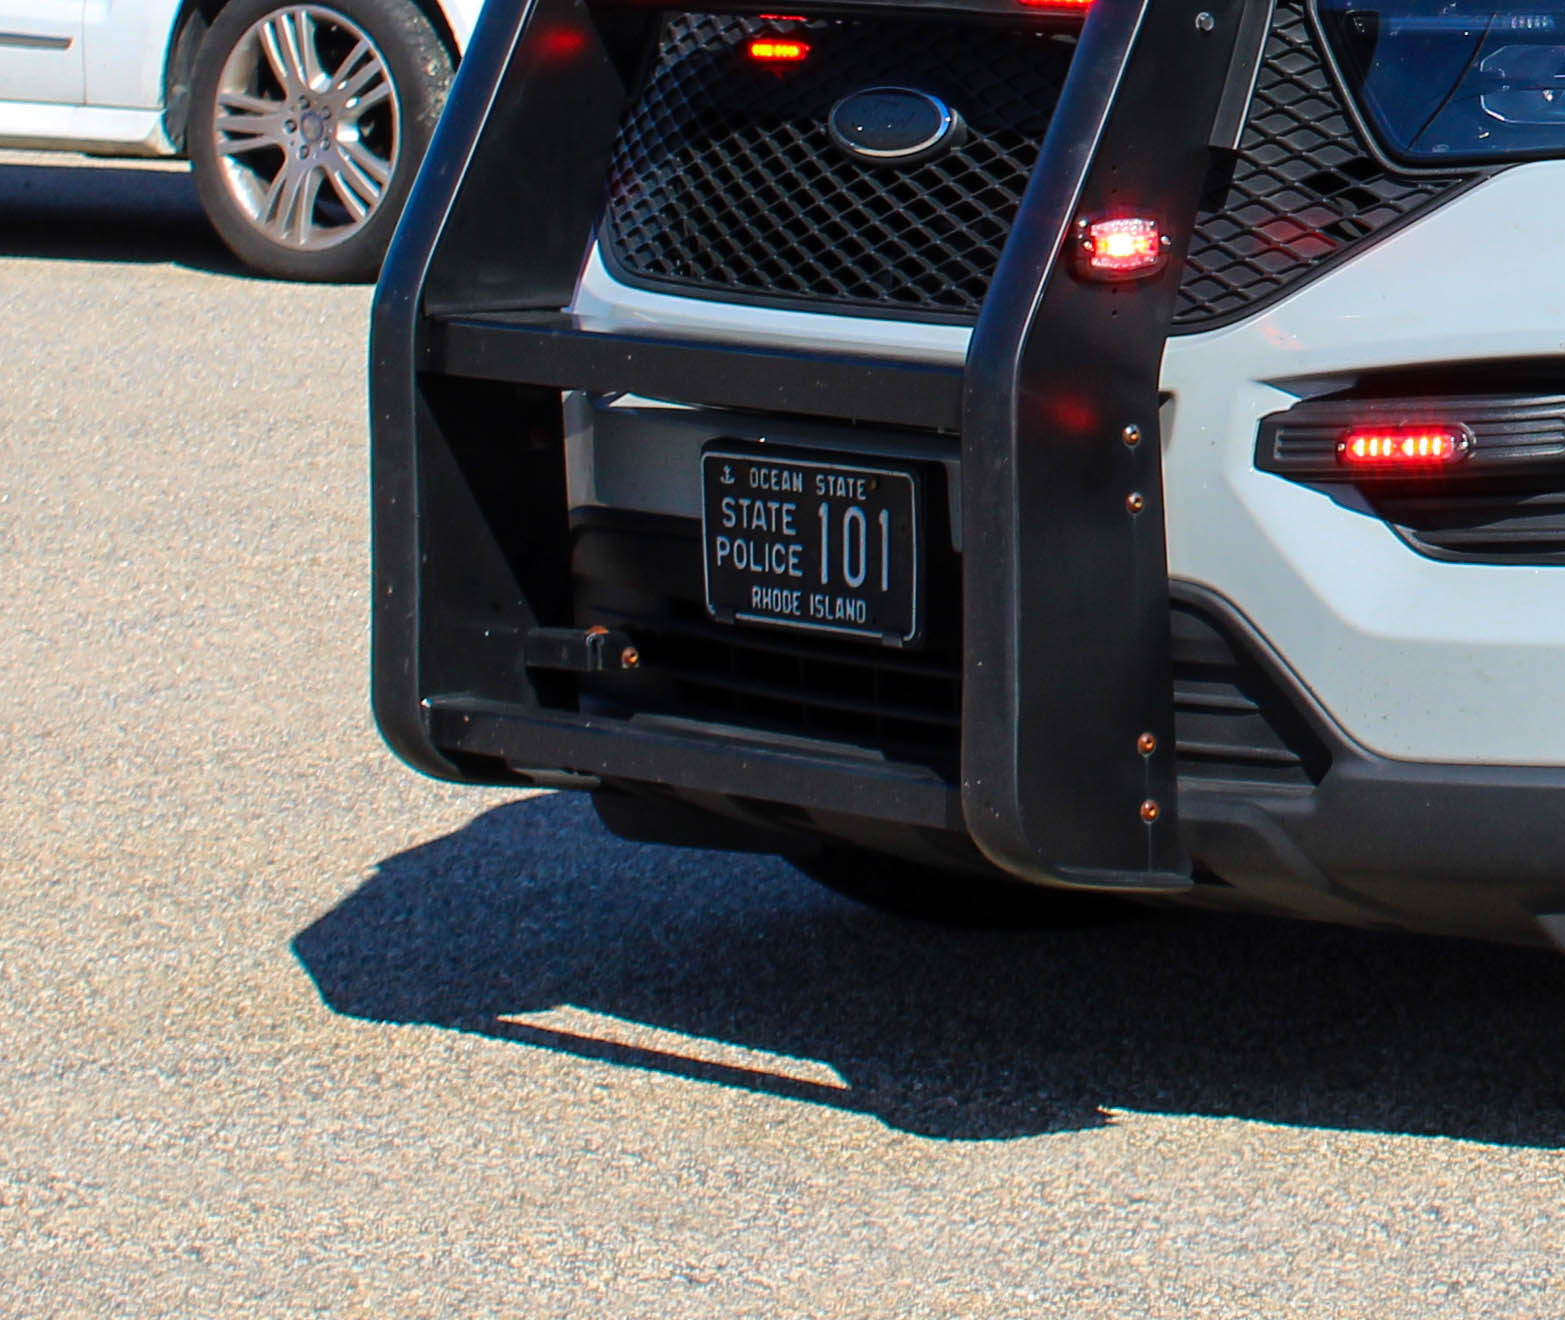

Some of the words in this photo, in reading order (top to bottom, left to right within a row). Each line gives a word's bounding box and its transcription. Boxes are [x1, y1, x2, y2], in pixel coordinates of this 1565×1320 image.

[749, 467, 803, 493] OCEAN
[815, 474, 867, 500] STATE
[715, 536, 803, 577] POLICE
[721, 496, 797, 536] STATE
[818, 501, 889, 592] 101
[751, 586, 801, 616] RHODE
[809, 594, 867, 624] ISLAND
